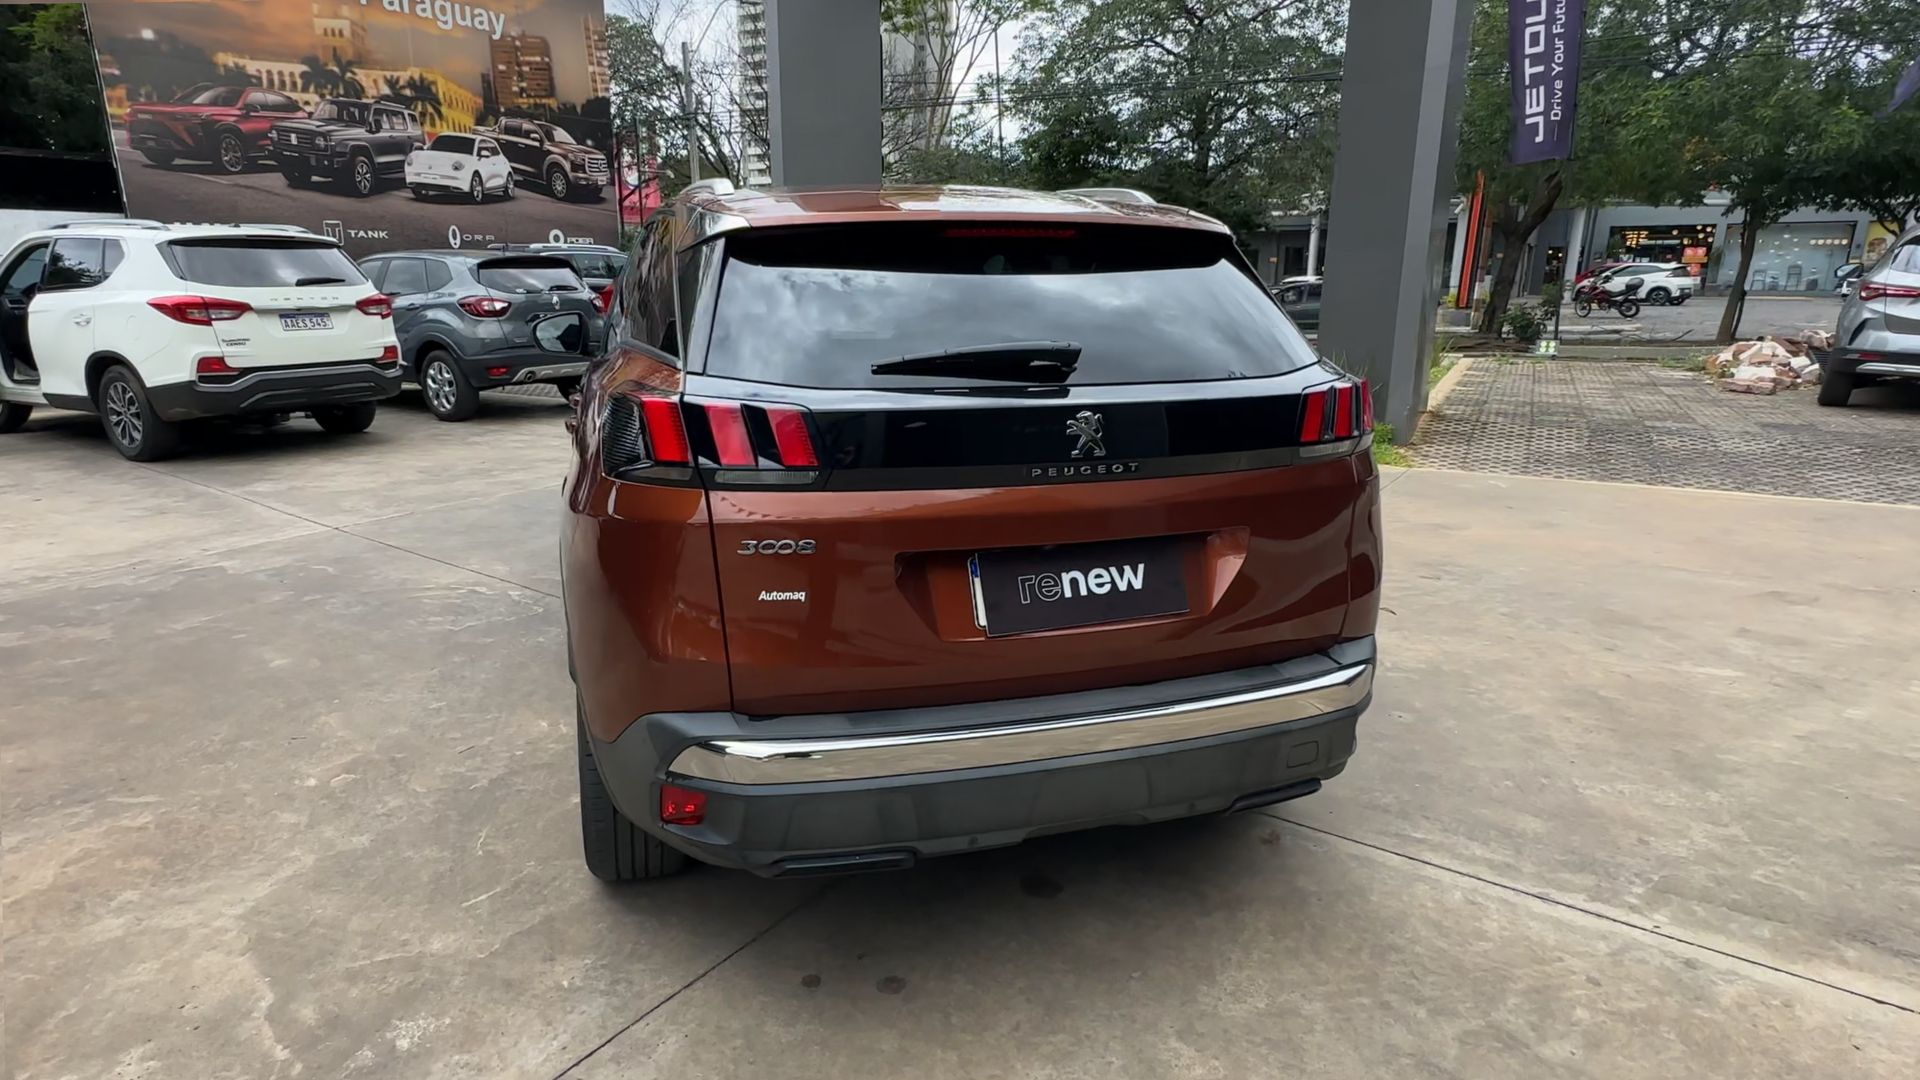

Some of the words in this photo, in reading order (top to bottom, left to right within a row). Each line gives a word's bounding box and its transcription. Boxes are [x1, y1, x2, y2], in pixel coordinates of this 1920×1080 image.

[360, 0, 505, 40] araguay
[1551, 37, 1565, 76] Your
[1550, 79, 1563, 121] Drive
[347, 229, 389, 240] TANK
[462, 233, 495, 242] ORA
[284, 318, 308, 329] AAES
[309, 317, 328, 328] 545
[1031, 462, 1139, 478] PEUGEOT
[736, 539, 817, 555] 3008
[1017, 562, 1145, 605] renew
[758, 590, 807, 603] Automaq
